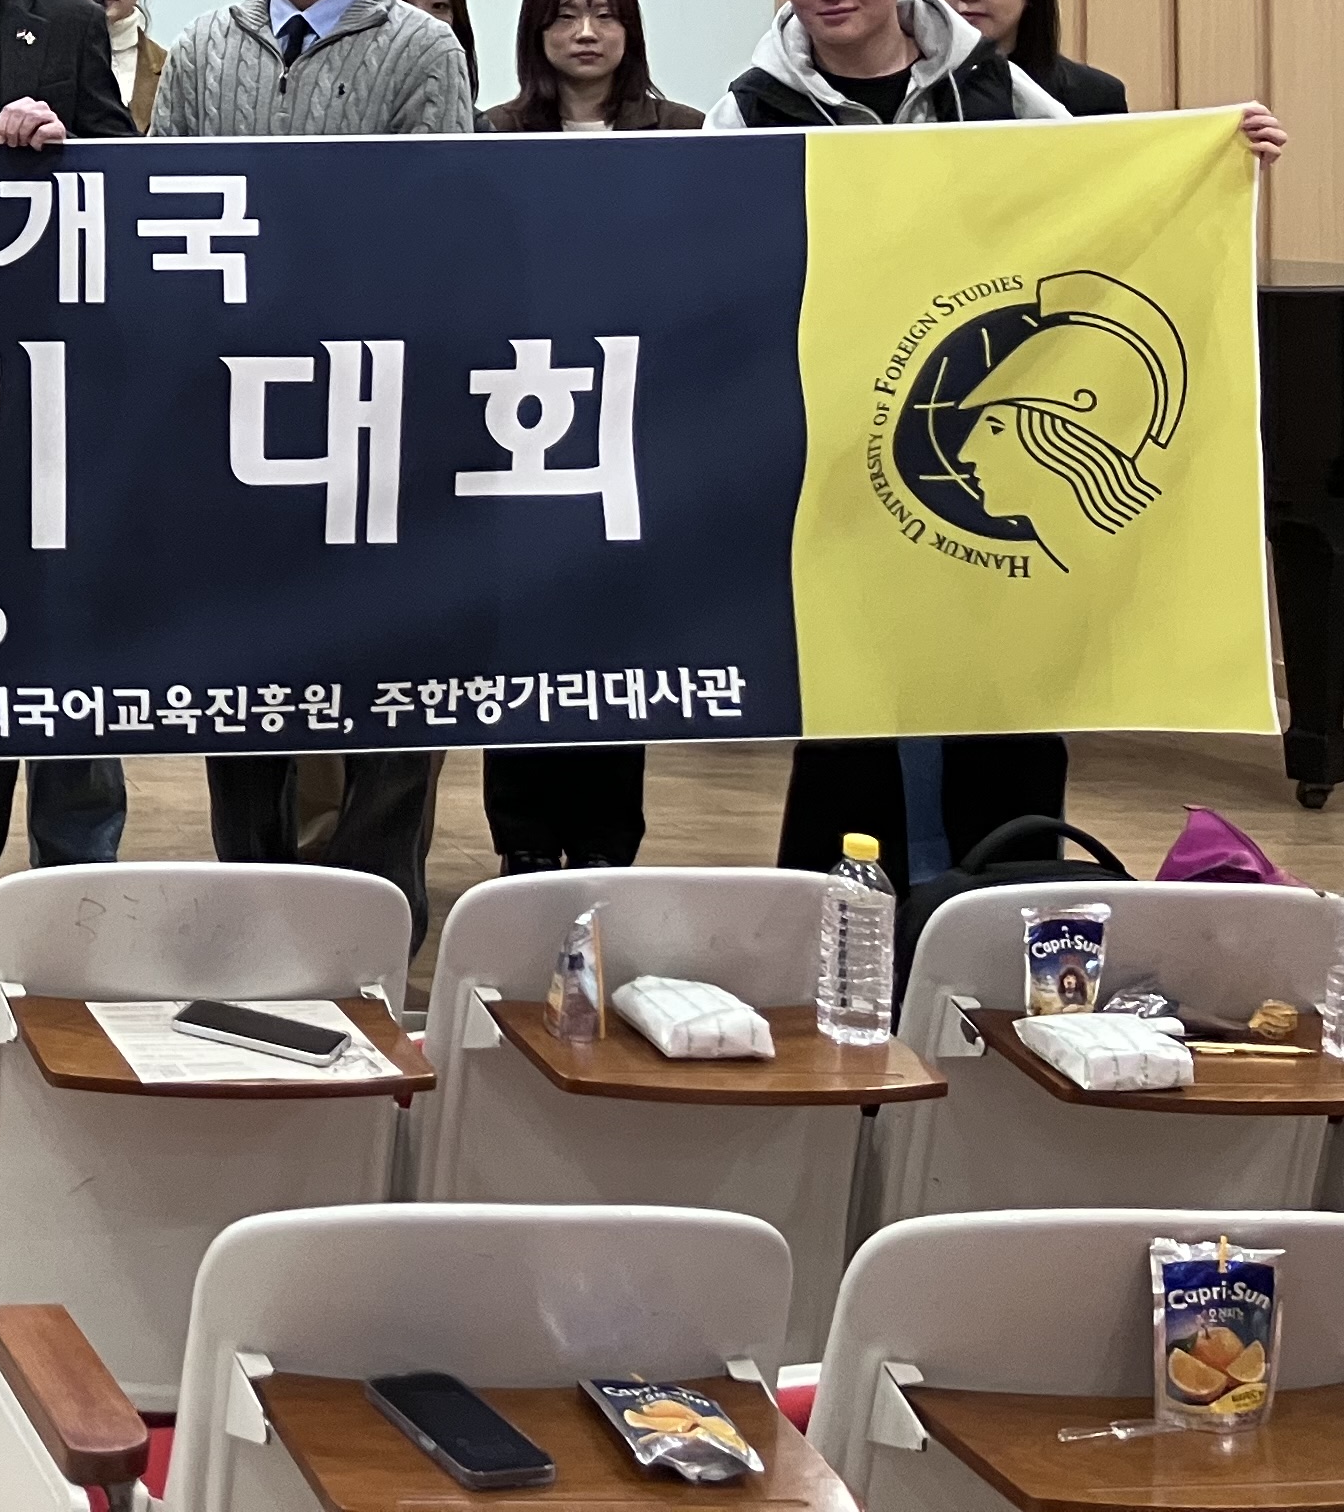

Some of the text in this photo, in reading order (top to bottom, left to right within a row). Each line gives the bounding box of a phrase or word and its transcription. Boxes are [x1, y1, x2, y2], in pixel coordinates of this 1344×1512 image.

[219, 336, 640, 544] 대회
[866, 275, 1031, 579] HANKUK UNIVERSITY OF FOREIGN STUDIES
[371, 667, 746, 726] 주한헝가리대사관
[1168, 1280, 1270, 1310] Capri-Sun
